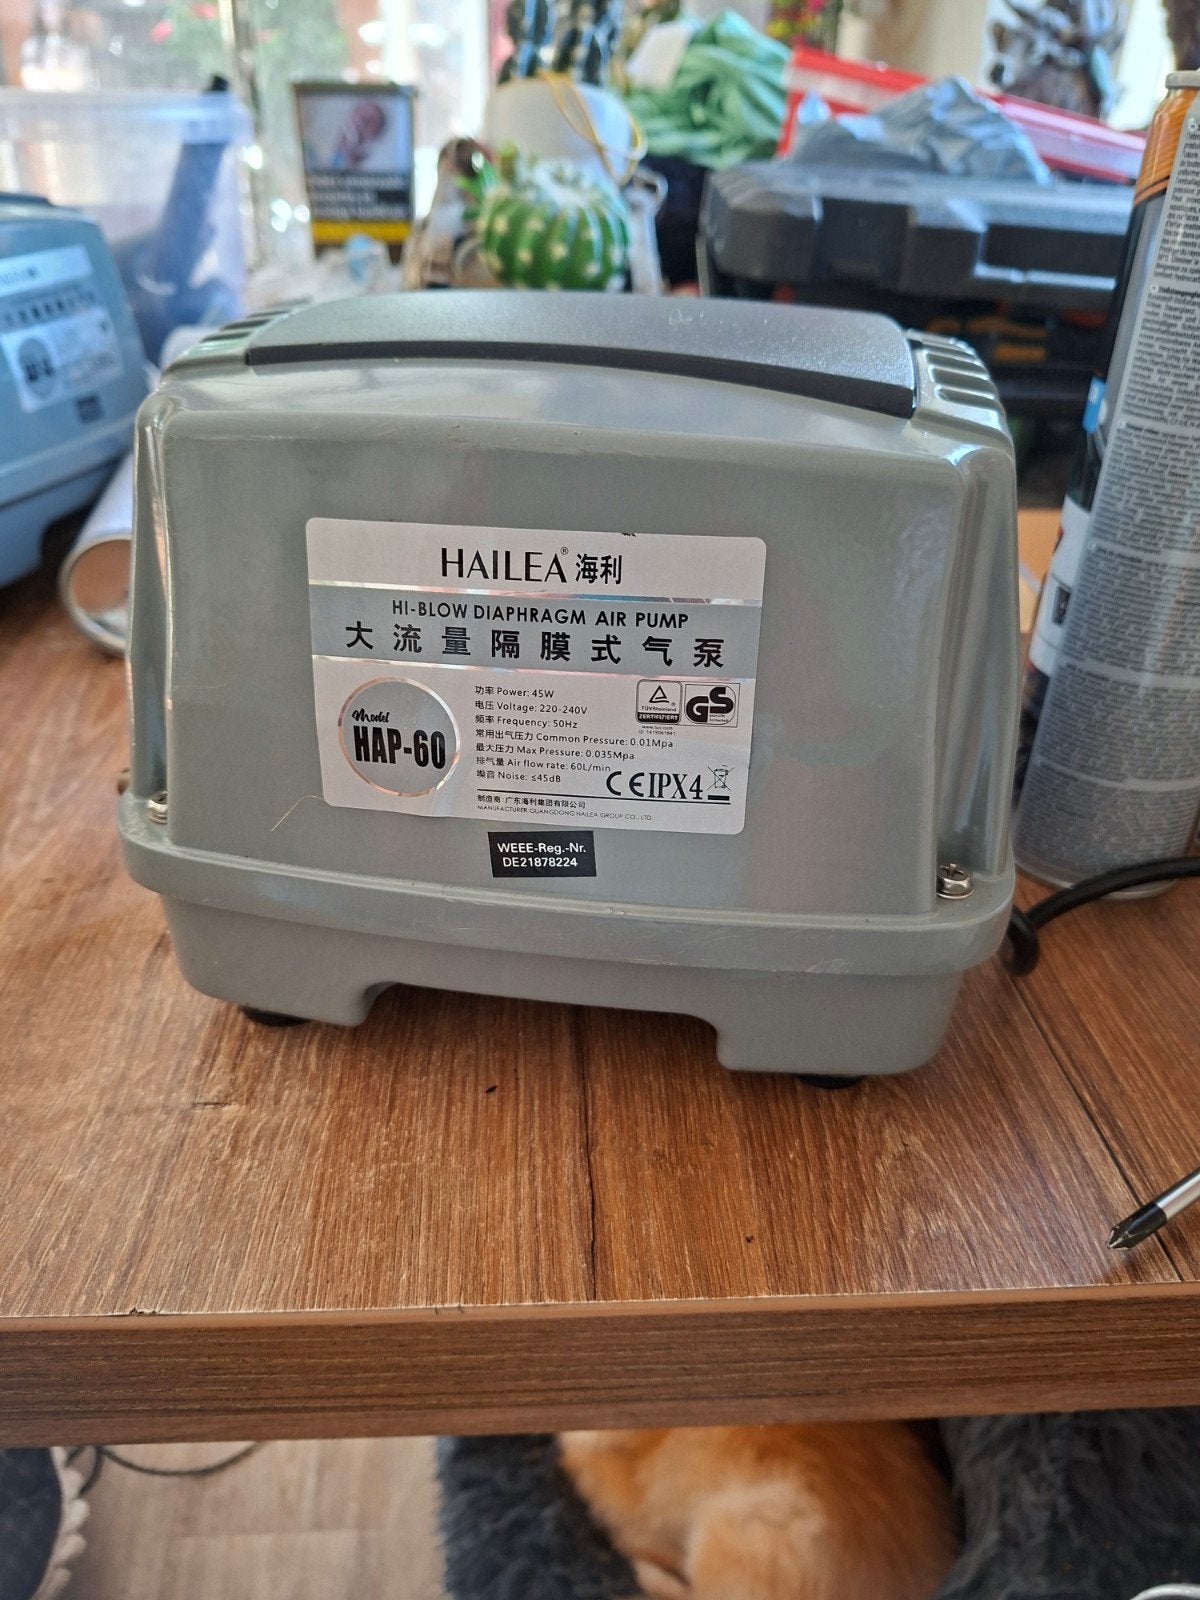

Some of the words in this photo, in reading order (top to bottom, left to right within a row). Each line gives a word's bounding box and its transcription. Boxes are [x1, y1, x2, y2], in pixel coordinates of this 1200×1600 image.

[575, 553, 623, 584] 海利
[392, 599, 468, 620] HI-BLOW
[473, 605, 587, 626] DIAPHRAGM
[595, 610, 627, 628] AIR
[635, 612, 689, 629] PUMP
[474, 685, 495, 696] 功率
[497, 686, 531, 698] Power:
[531, 689, 555, 699] 45W
[474, 700, 495, 711] 电压
[497, 701, 537, 714] Voltage:
[539, 703, 588, 715] 220-240V
[686, 686, 734, 723] GS
[351, 708, 390, 723] Model
[474, 714, 495, 725] 频率
[497, 716, 550, 729] Frequency:
[552, 718, 578, 729] 50Hz
[475, 728, 534, 742] 常用出气压力
[536, 732, 580, 744] Common
[583, 735, 628, 747] Pressure:
[630, 737, 674, 749] 0.01Mpa
[353, 725, 446, 770] HAP-60
[475, 742, 514, 755] 最大压力
[516, 745, 537, 756] Max
[539, 746, 584, 759] Pressure:
[585, 749, 635, 761] 0.035Mpa
[476, 756, 505, 768] 排气量
[507, 757, 522, 768] Air
[523, 758, 544, 769] flow
[546, 761, 569, 771] rate:
[570, 762, 612, 773] 60L/min
[497, 771, 528, 782] Noise:
[530, 773, 562, 784] ≤45dB
[648, 772, 703, 800] IPX4
[497, 842, 587, 855] WEEE-Reg.-Nr.
[502, 856, 578, 868] DE21878224
